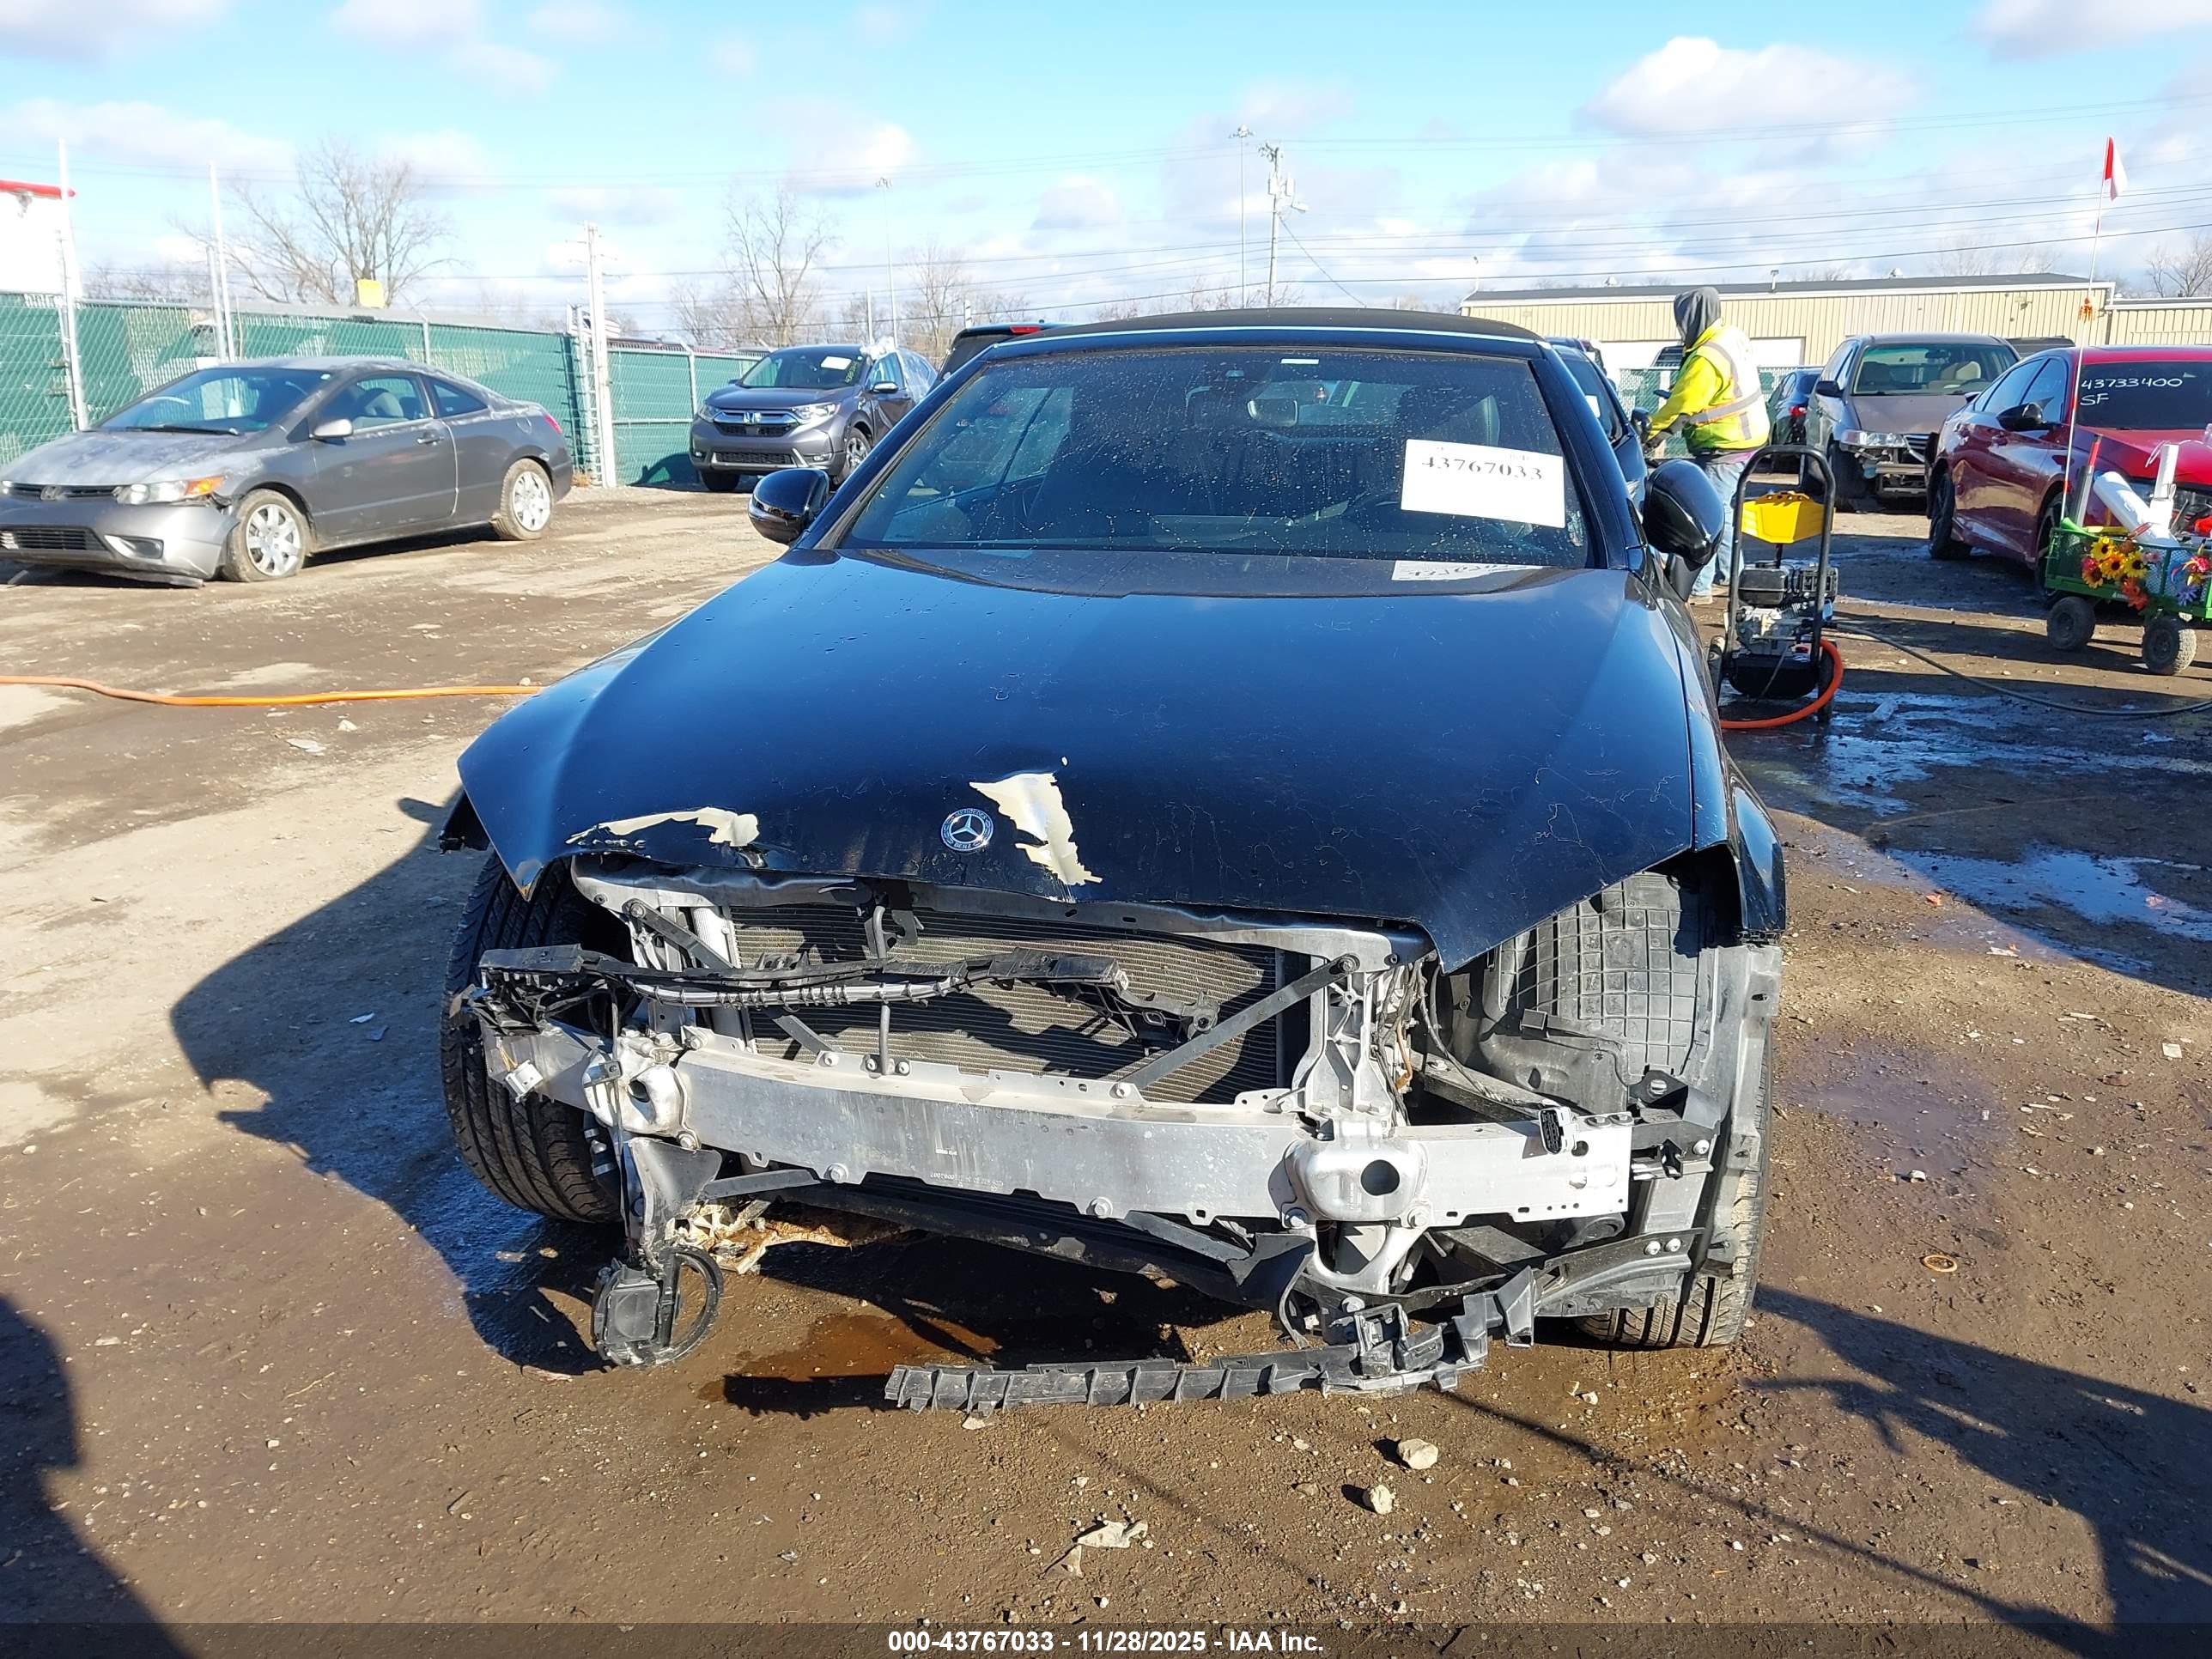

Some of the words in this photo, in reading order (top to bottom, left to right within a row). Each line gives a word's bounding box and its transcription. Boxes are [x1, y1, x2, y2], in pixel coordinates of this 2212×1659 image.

[2081, 377, 2183, 390] 43733400
[2080, 392, 2110, 406] SF
[1421, 456, 1543, 481] 43767033
